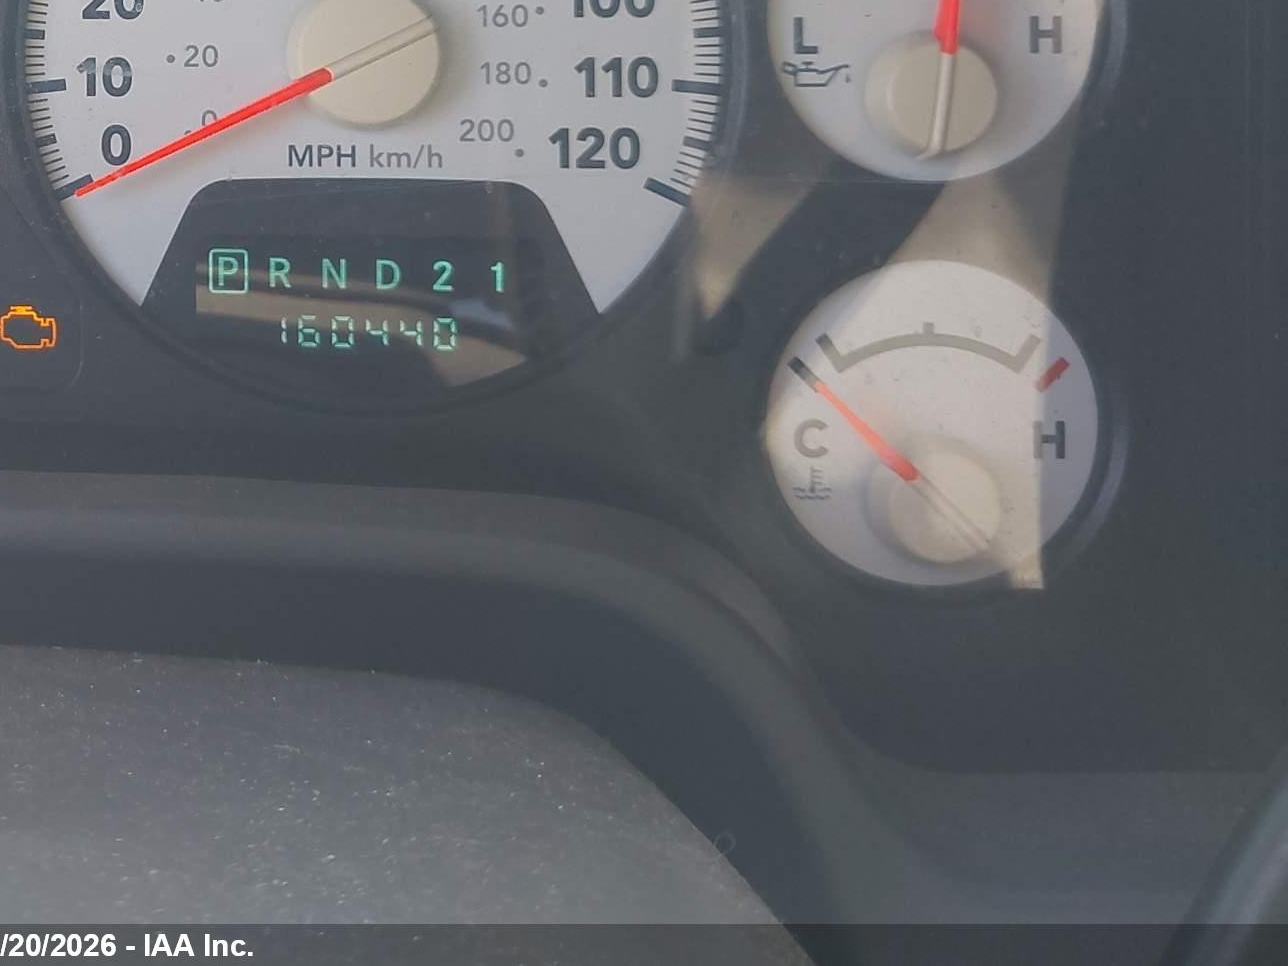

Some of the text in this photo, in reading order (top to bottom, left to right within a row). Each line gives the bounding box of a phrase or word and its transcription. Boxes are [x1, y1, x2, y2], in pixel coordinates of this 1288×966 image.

[477, 4, 529, 27] 160
[1029, 15, 1061, 54] H
[794, 16, 818, 55] L
[184, 45, 219, 67] 20
[481, 62, 531, 85] 180
[77, 57, 132, 96] 10
[573, 58, 659, 97] 110
[101, 125, 131, 165] 0
[459, 119, 514, 143] 200
[549, 128, 640, 169] 120
[288, 145, 443, 170] MPH km/h
[217, 257, 505, 292] P R N D 2 1
[279, 315, 457, 351] 160440
[794, 419, 827, 458] C
[1033, 420, 1066, 459] H
